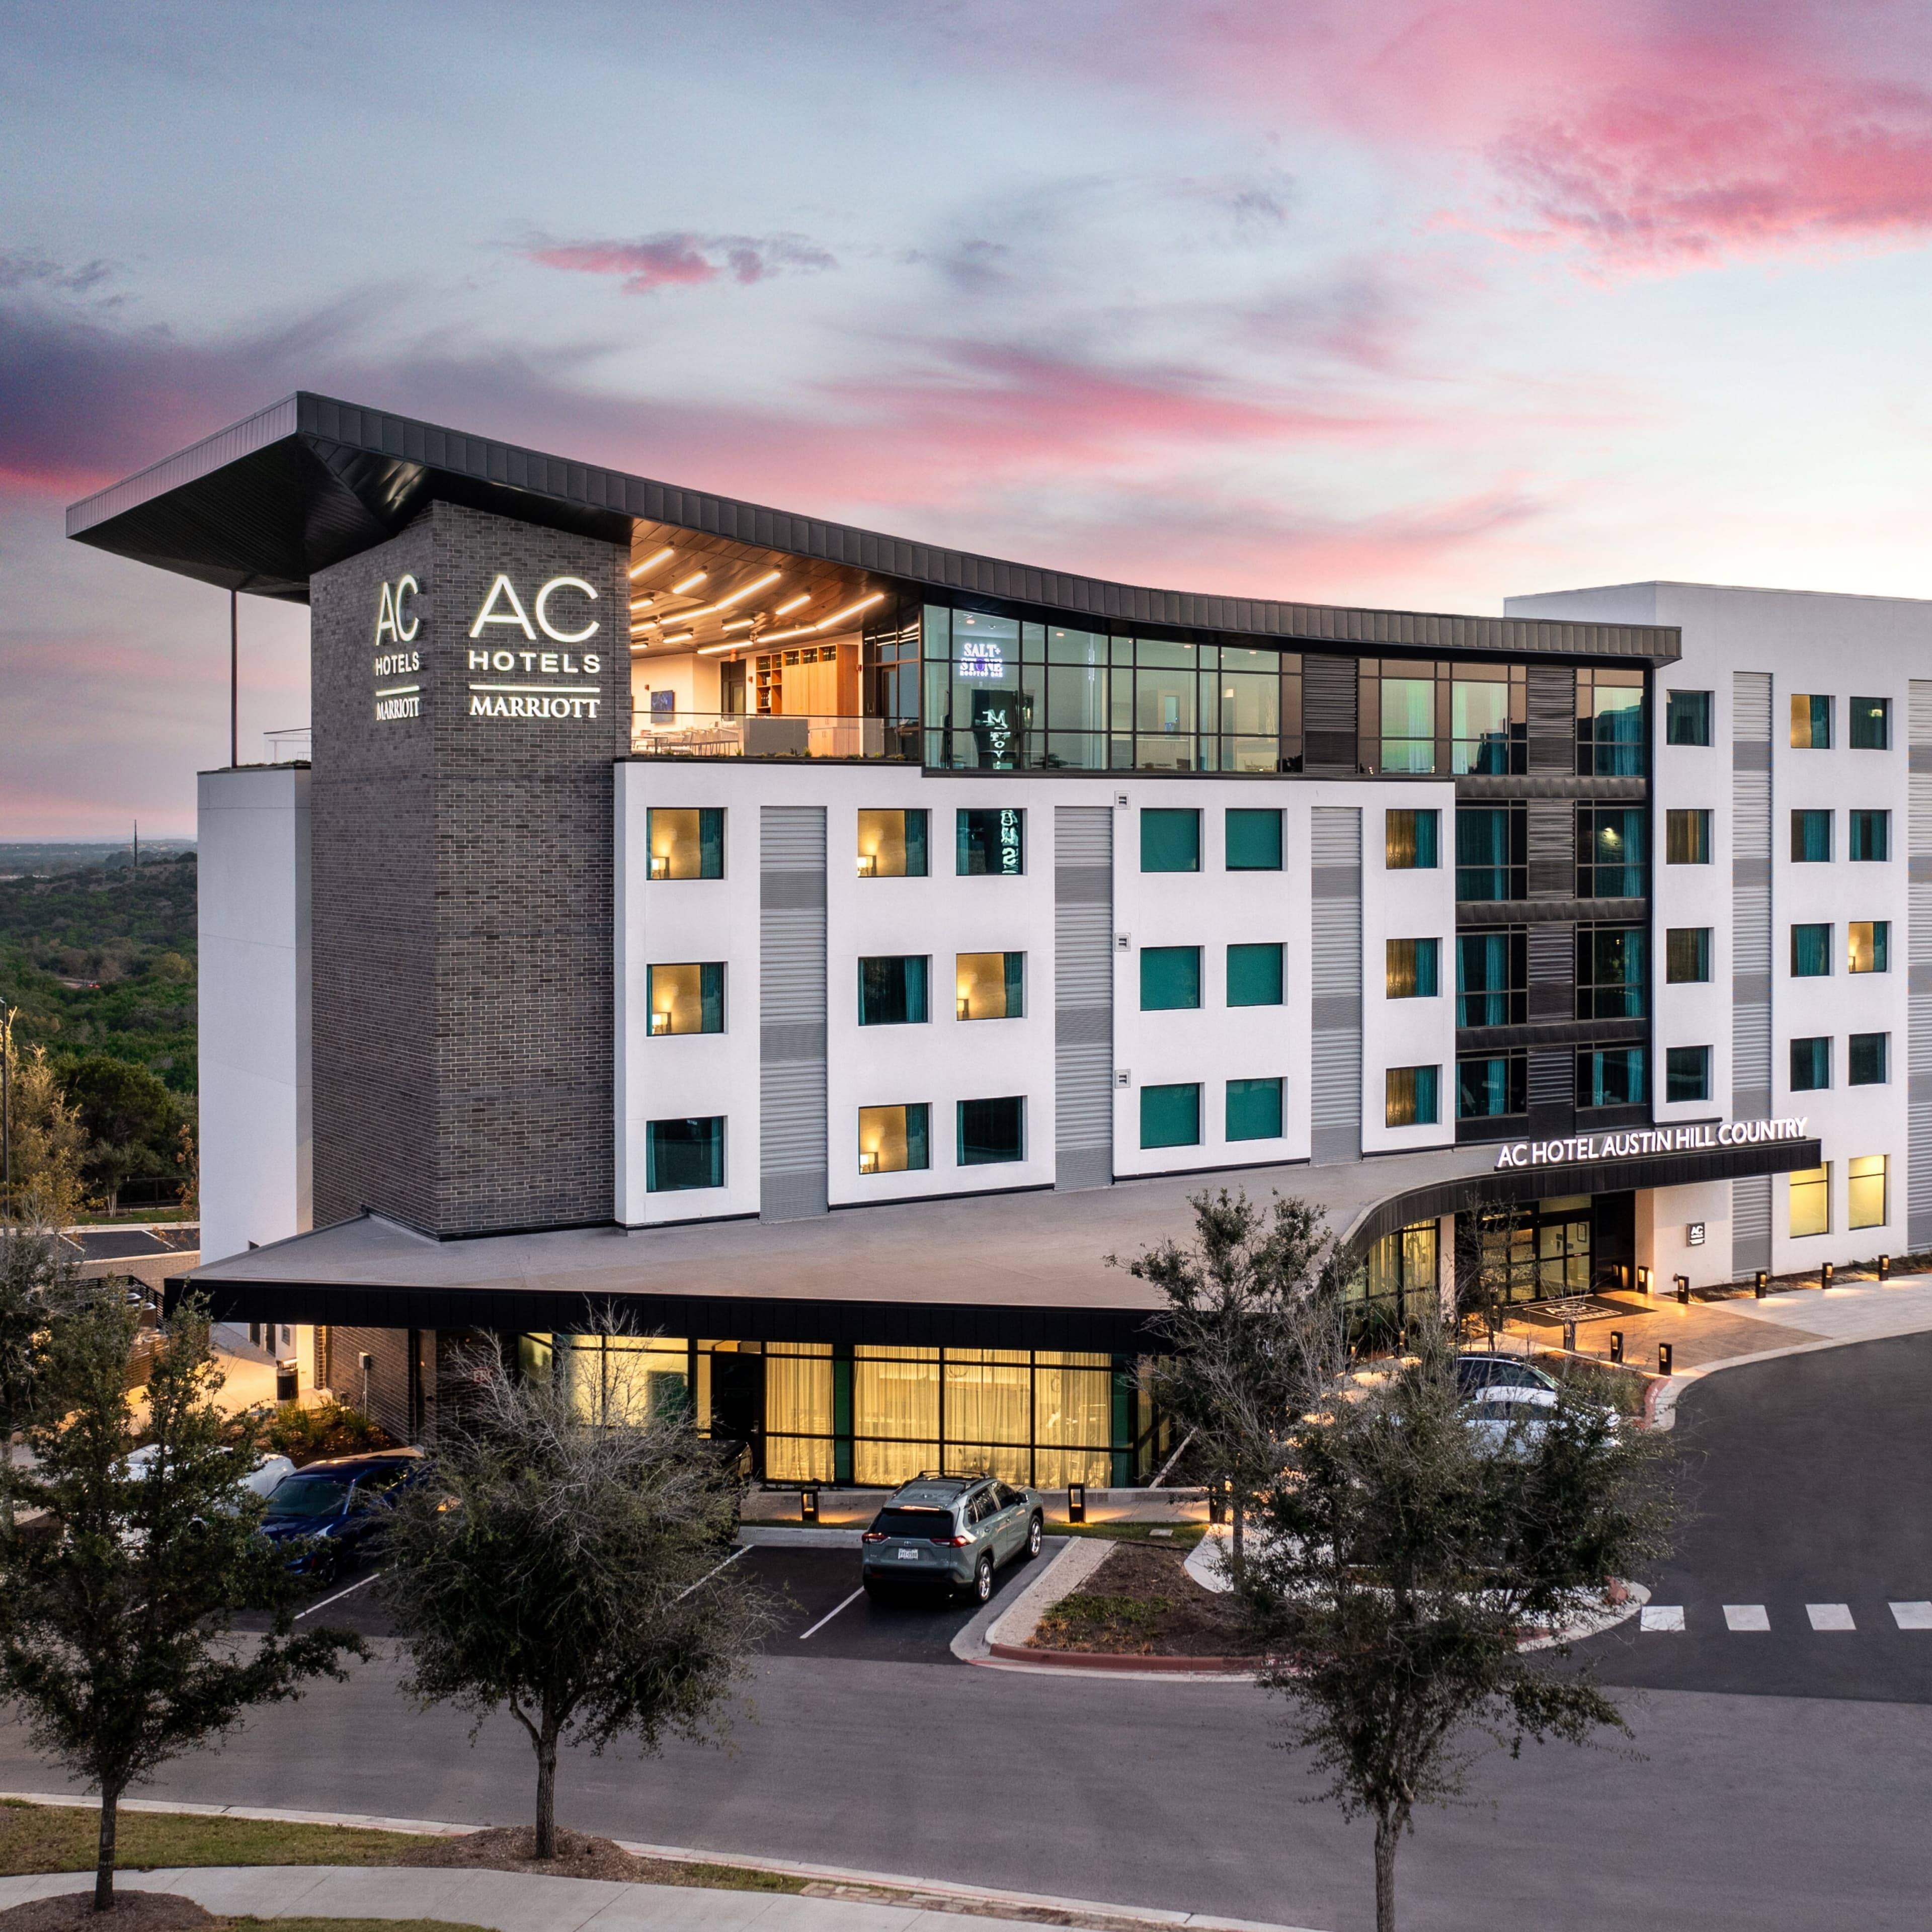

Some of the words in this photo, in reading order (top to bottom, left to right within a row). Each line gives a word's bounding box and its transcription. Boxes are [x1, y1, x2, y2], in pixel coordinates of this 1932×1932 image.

[376, 574, 419, 646] AC
[469, 574, 600, 642] AC
[375, 651, 419, 676] HOTELS
[469, 650, 600, 673] HOTELS
[959, 657, 1003, 672] STONE
[376, 697, 419, 721] MARRIOTT
[469, 696, 600, 718] MARRIOTT
[1497, 1144, 1527, 1167] AC
[1532, 1138, 1600, 1164] HOTEL
[1601, 1130, 1671, 1157] AUSTIN
[1675, 1126, 1716, 1149] HILL
[1717, 1117, 1808, 1145] COUNTRY
[1691, 1225, 1703, 1235] AC
